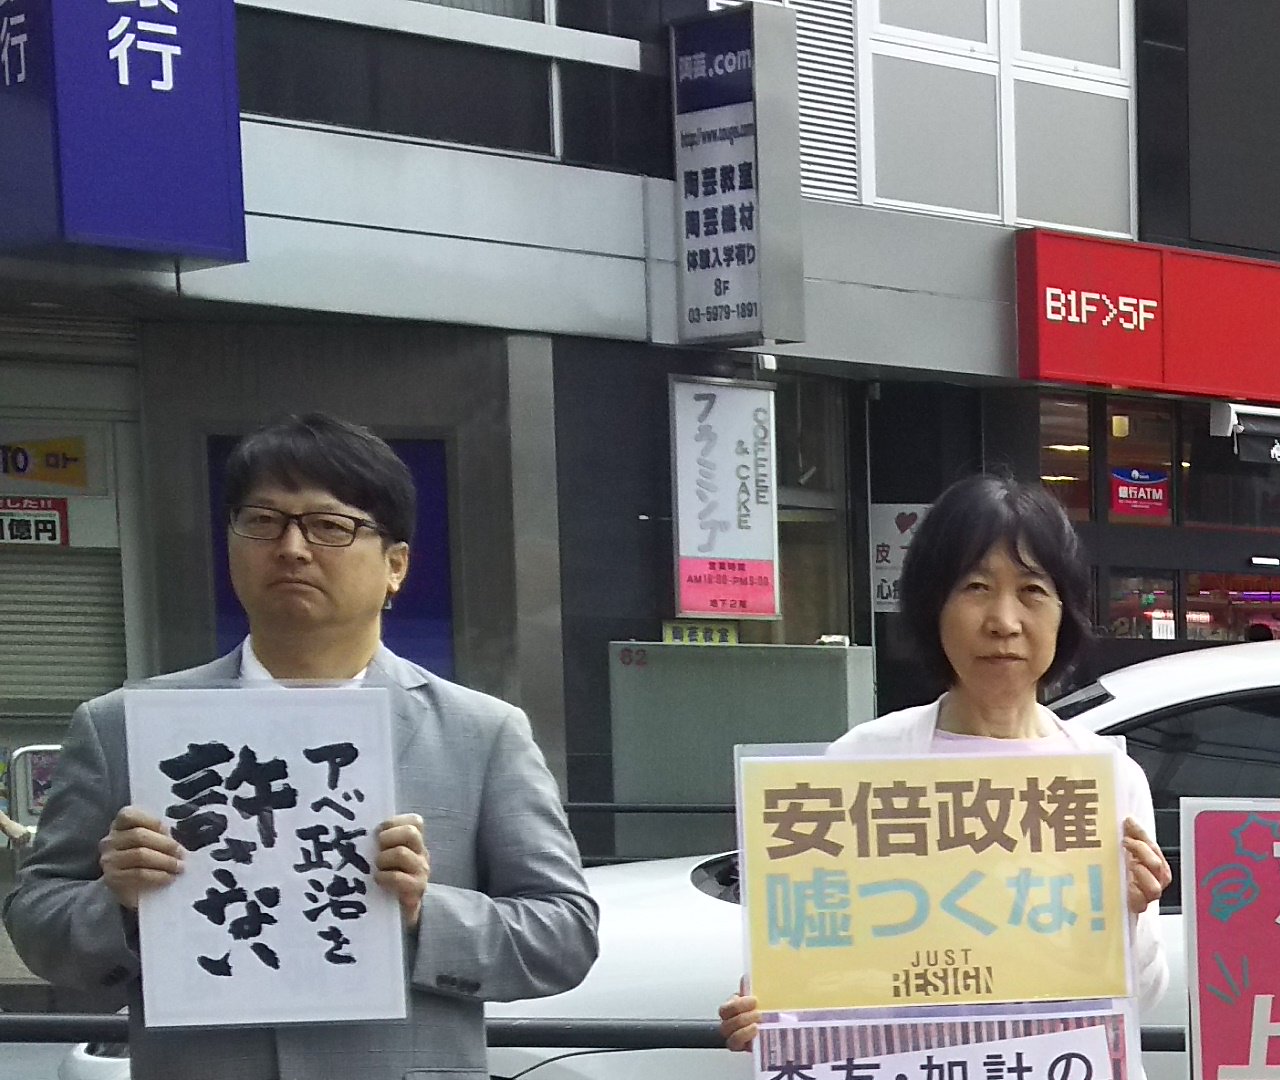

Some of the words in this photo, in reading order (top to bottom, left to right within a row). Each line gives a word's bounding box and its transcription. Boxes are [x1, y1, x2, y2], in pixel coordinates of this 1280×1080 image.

[714, 278, 730, 297] 8F
[159, 740, 299, 978] 許さない
[293, 741, 371, 965] アベ政治を
[763, 776, 1103, 861] 安倍政権
[765, 863, 1106, 951] 嘘つくな!
[910, 948, 973, 968] JUST
